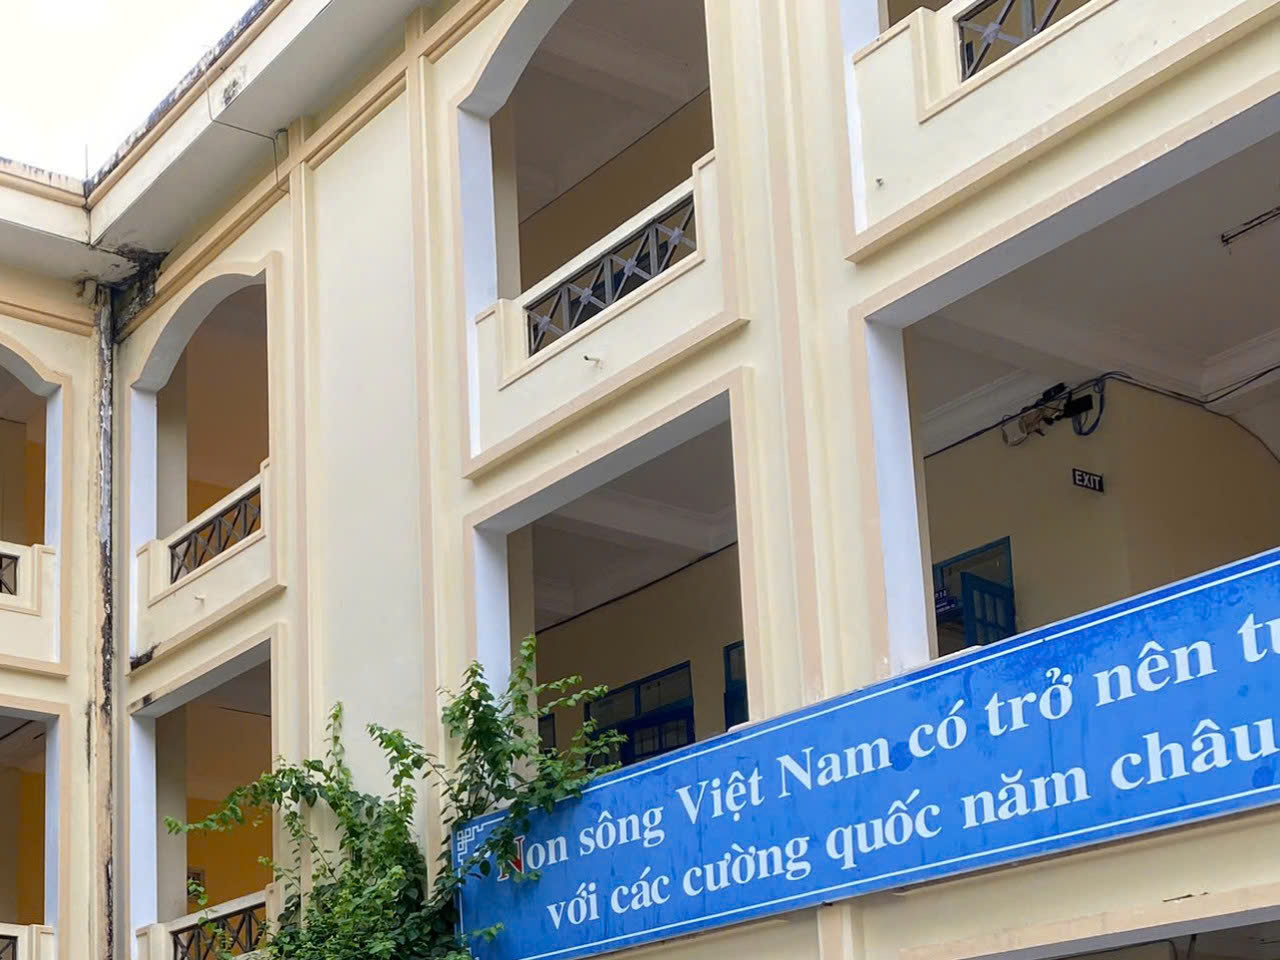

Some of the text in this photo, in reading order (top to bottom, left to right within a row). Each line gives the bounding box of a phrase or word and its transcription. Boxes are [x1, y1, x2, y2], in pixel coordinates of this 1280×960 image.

[1075, 471, 1100, 490] EXIT
[545, 716, 1280, 931] với các cường quốc năm châu
[578, 810, 666, 858] sông
[675, 768, 765, 827] Việt
[777, 736, 892, 799] Nam
[909, 699, 969, 759] có
[984, 666, 1074, 737] trở
[1091, 640, 1218, 708] nên
